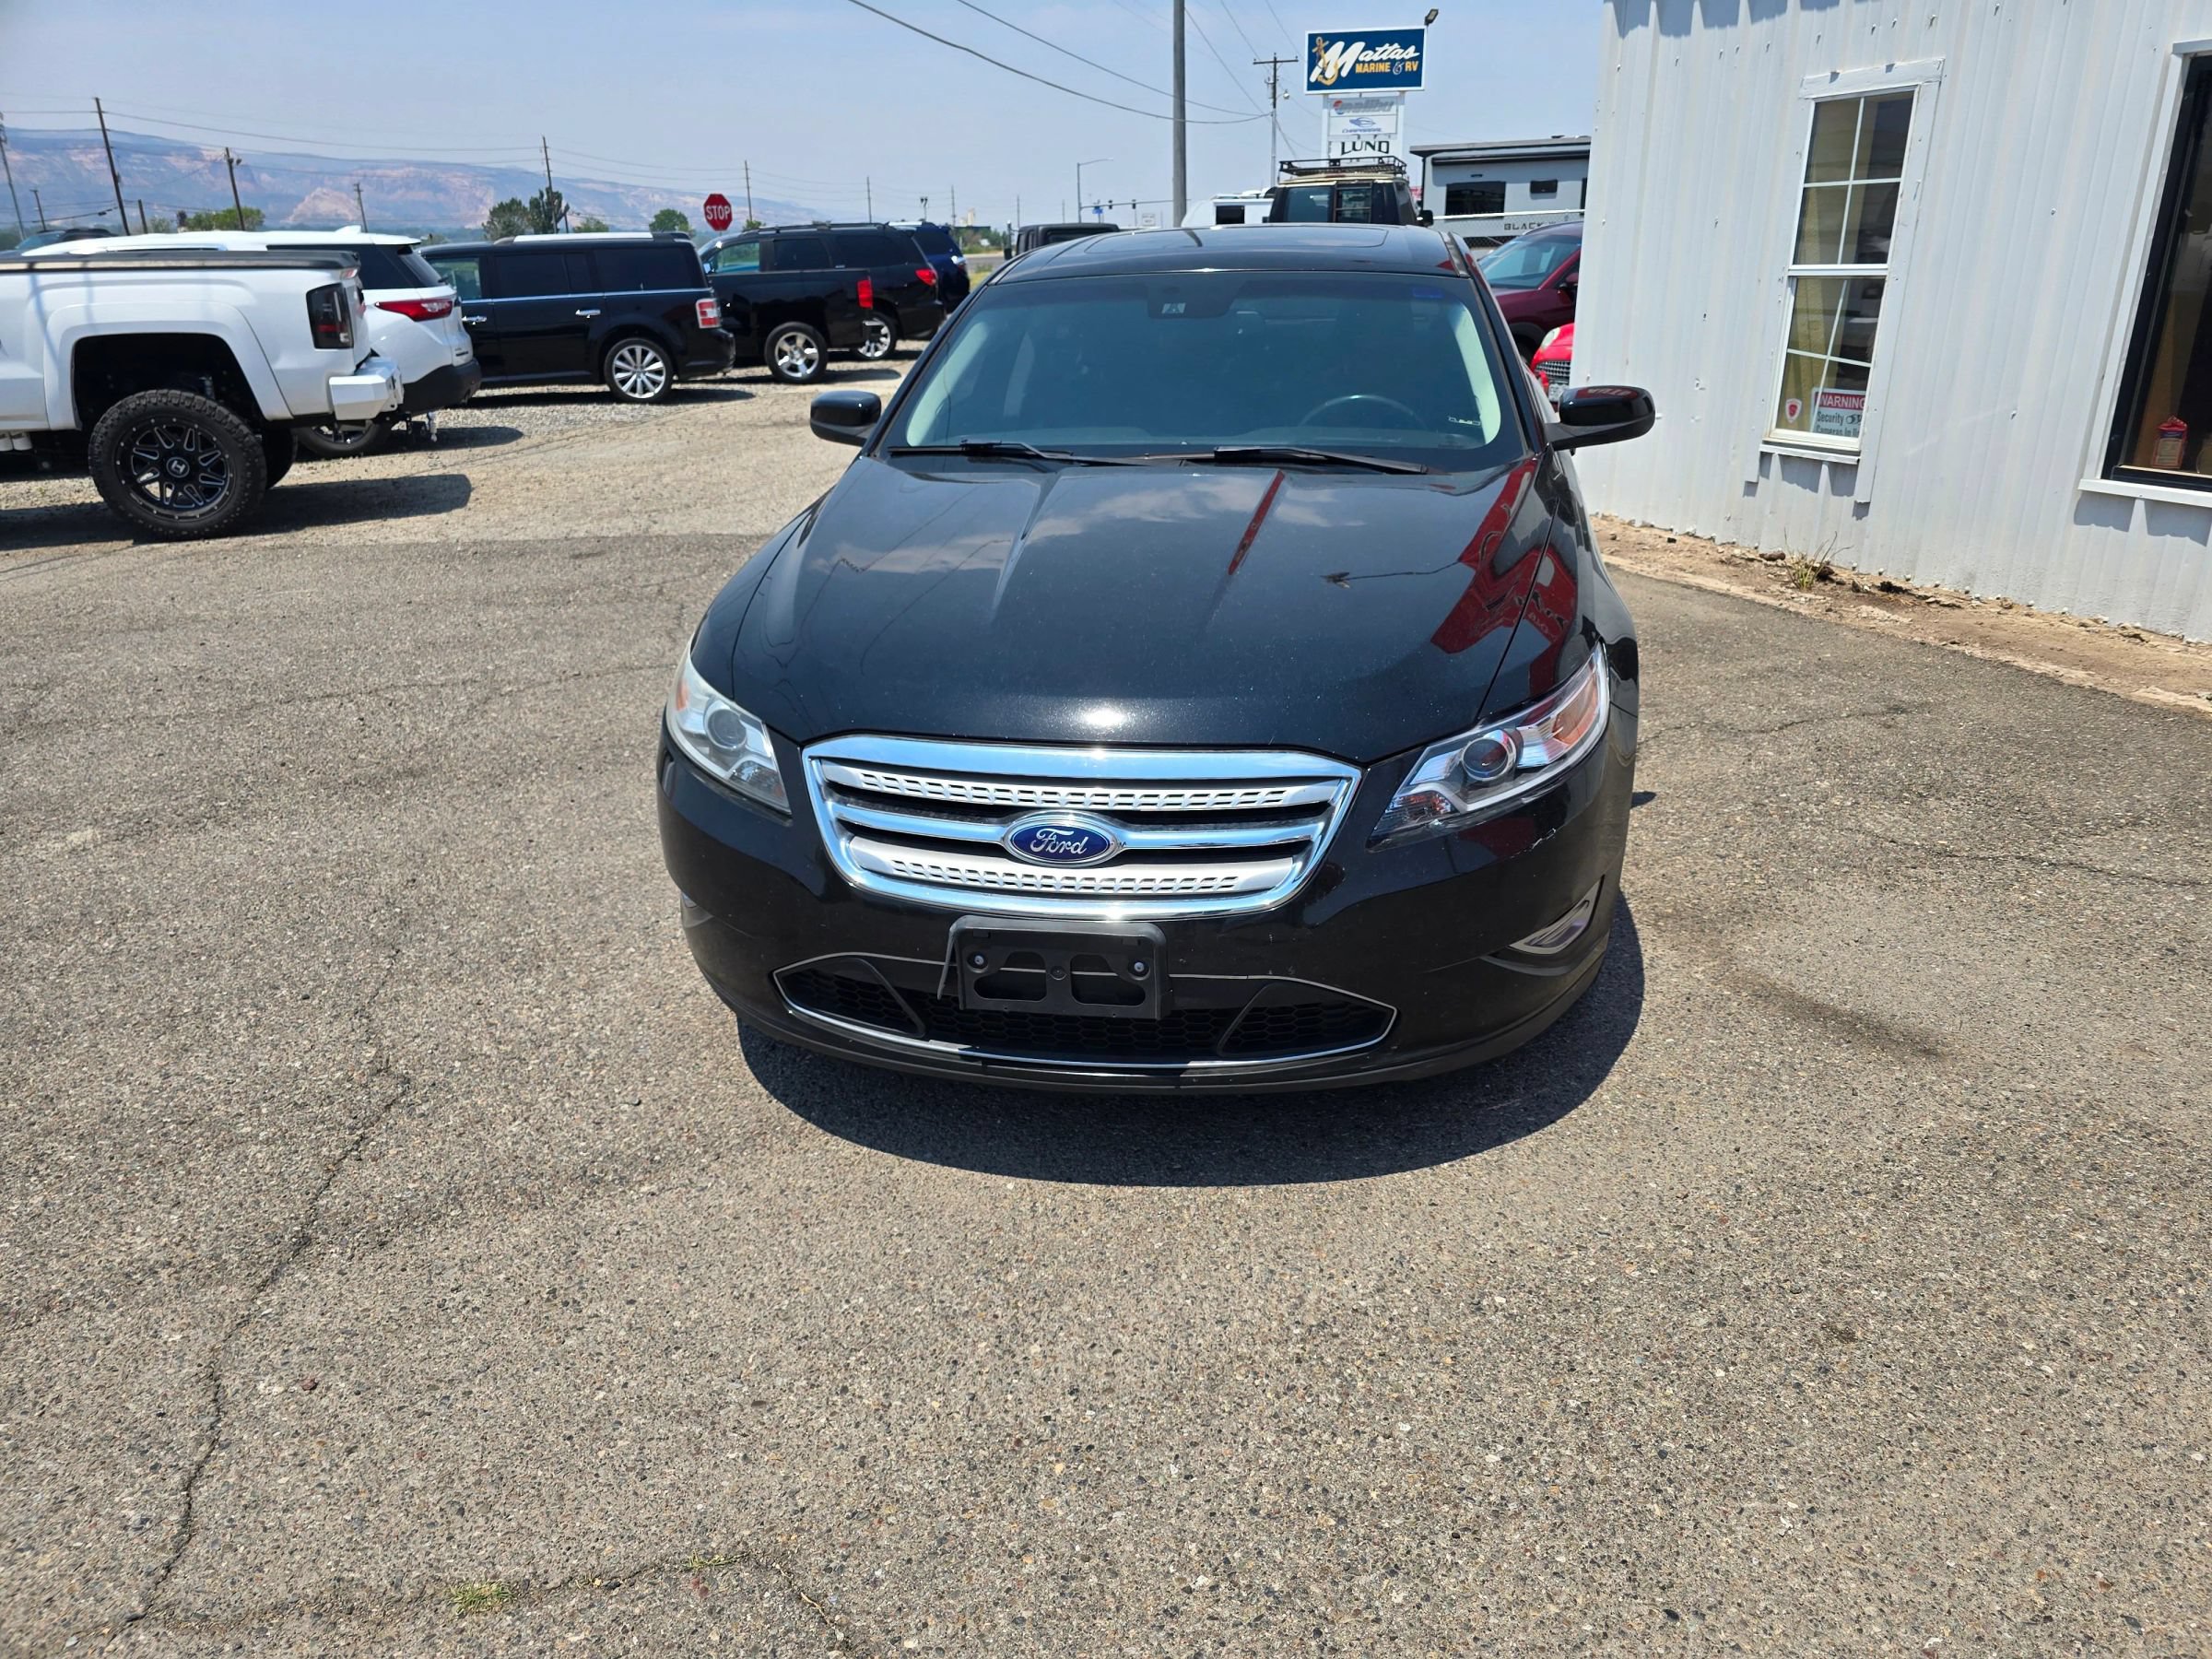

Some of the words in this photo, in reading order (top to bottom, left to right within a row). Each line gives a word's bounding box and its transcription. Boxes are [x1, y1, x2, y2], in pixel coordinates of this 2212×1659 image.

[1309, 41, 1420, 83] Mattas
[1356, 62, 1391, 73] MARINE
[1406, 61, 1418, 71] RV
[1341, 140, 1390, 156] LUND
[706, 205, 731, 220] STOP
[1818, 411, 1843, 425] Security
[1030, 828, 1089, 854] Ford
